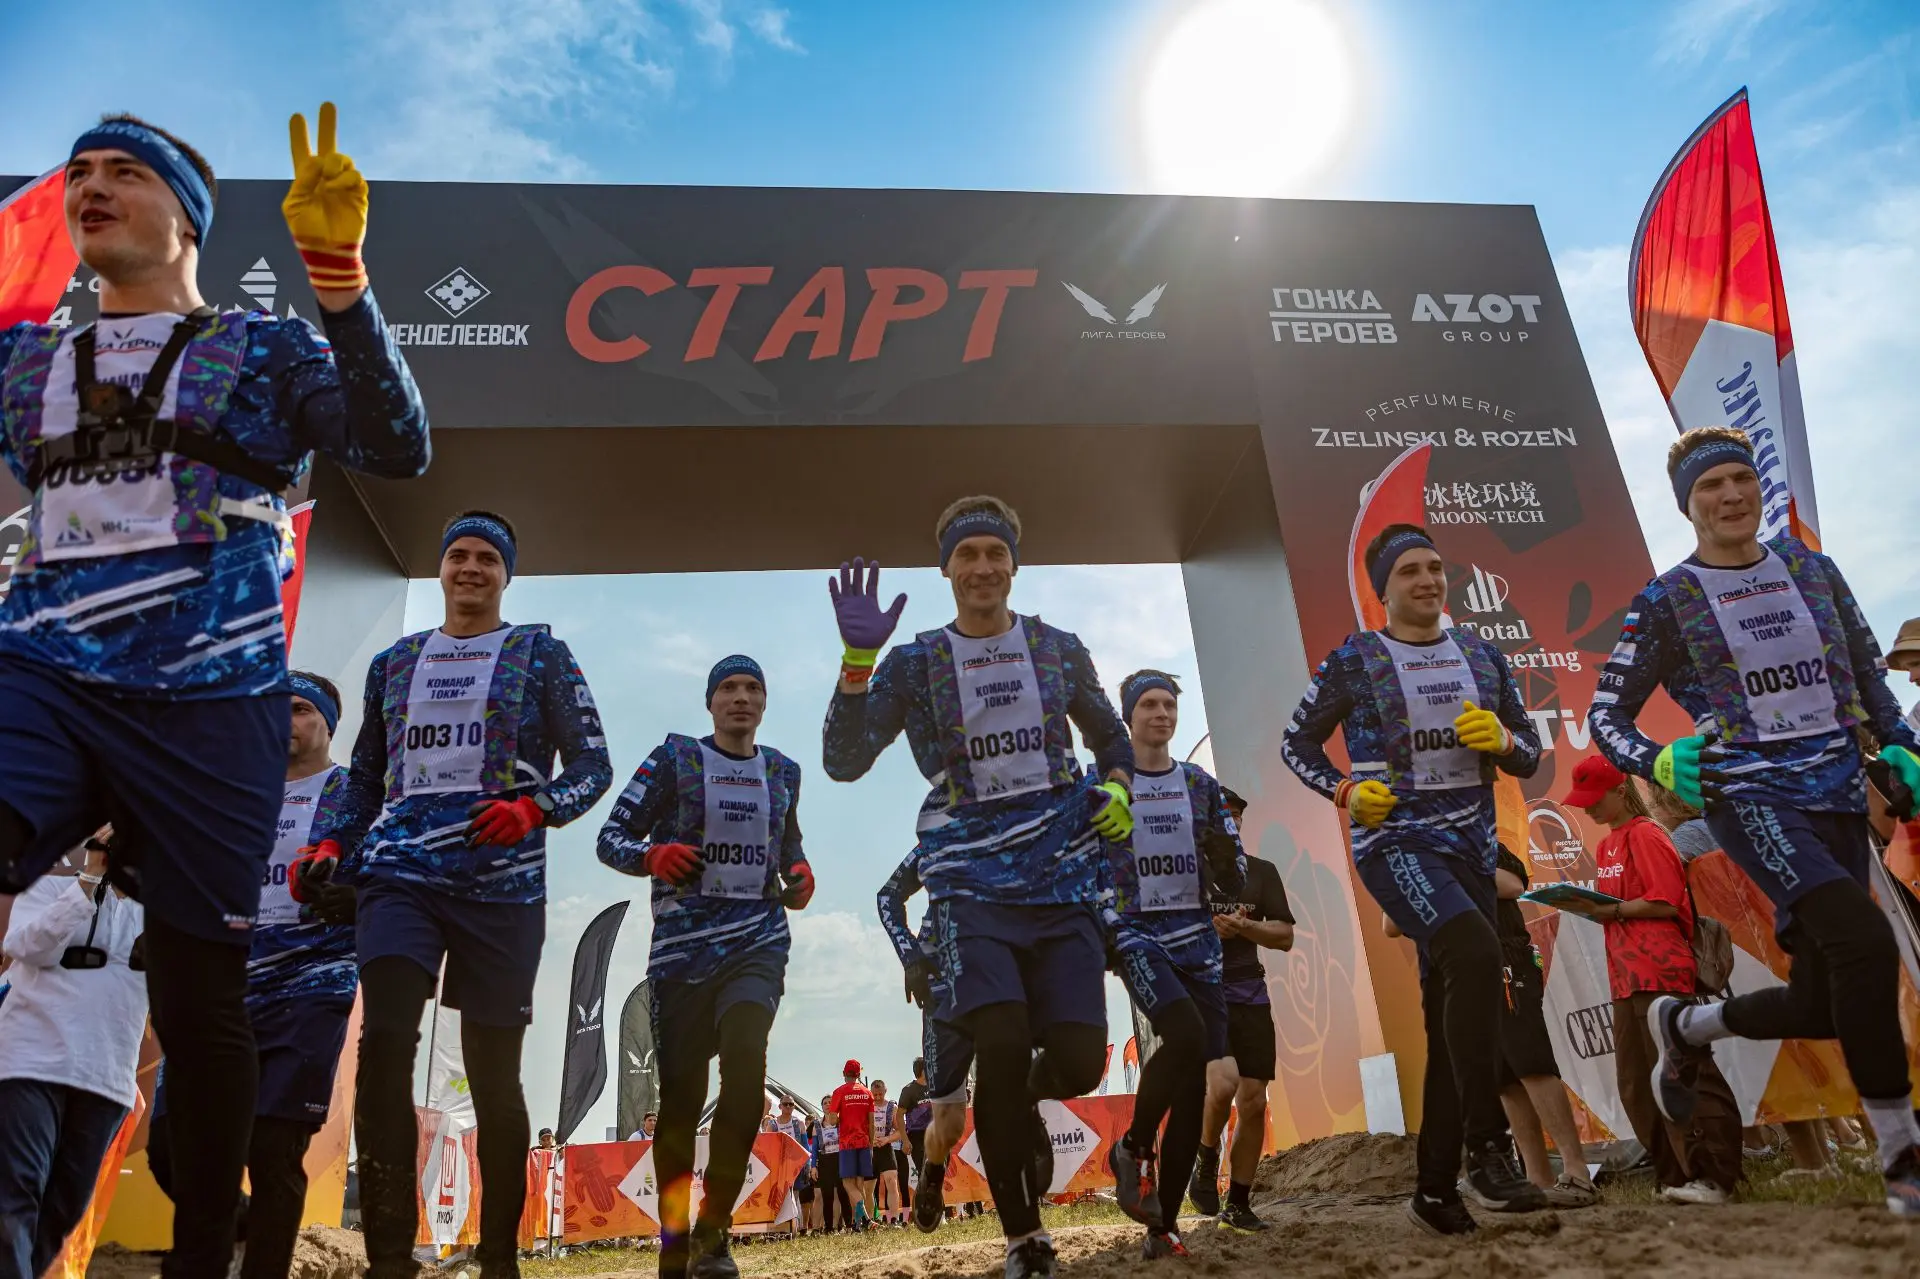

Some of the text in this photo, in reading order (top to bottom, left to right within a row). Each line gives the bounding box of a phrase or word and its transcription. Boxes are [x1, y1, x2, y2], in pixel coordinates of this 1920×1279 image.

[1272, 288, 1383, 310] ГОНКА
[1411, 293, 1542, 323] AZOT
[565, 265, 1039, 363] СТАРТ
[1081, 331, 1167, 339] ЛИГА ГЕРОЕВ
[1271, 321, 1398, 344] ГЕРОЕВ
[1443, 331, 1529, 342] GROUP
[1366, 394, 1516, 423] PERFUMERIE
[1311, 427, 1578, 447] ZIELINSKI & ROZEN
[1424, 482, 1541, 509] 冰轮环境
[1430, 511, 1546, 525] MOON-TECH
[1717, 580, 1789, 601] ГОНКА ГЕРОЕВ
[1461, 620, 1532, 640] Total
[1739, 610, 1796, 631] КОМАНДА
[962, 652, 1025, 667] ГОНКА ГЕРОЕВ
[1503, 647, 1582, 672] eering
[426, 676, 476, 689] КОМАНДА
[1417, 680, 1464, 695] КОМАНДА
[1745, 658, 1828, 697] 00302
[976, 680, 1024, 697] КОМАНДА
[407, 722, 482, 750] 00310
[969, 726, 1043, 761] 00303
[719, 799, 759, 812] КОМАНДА
[1142, 813, 1183, 825] КОМАНДА
[706, 843, 766, 866] 00305
[1138, 854, 1197, 877] 00306
